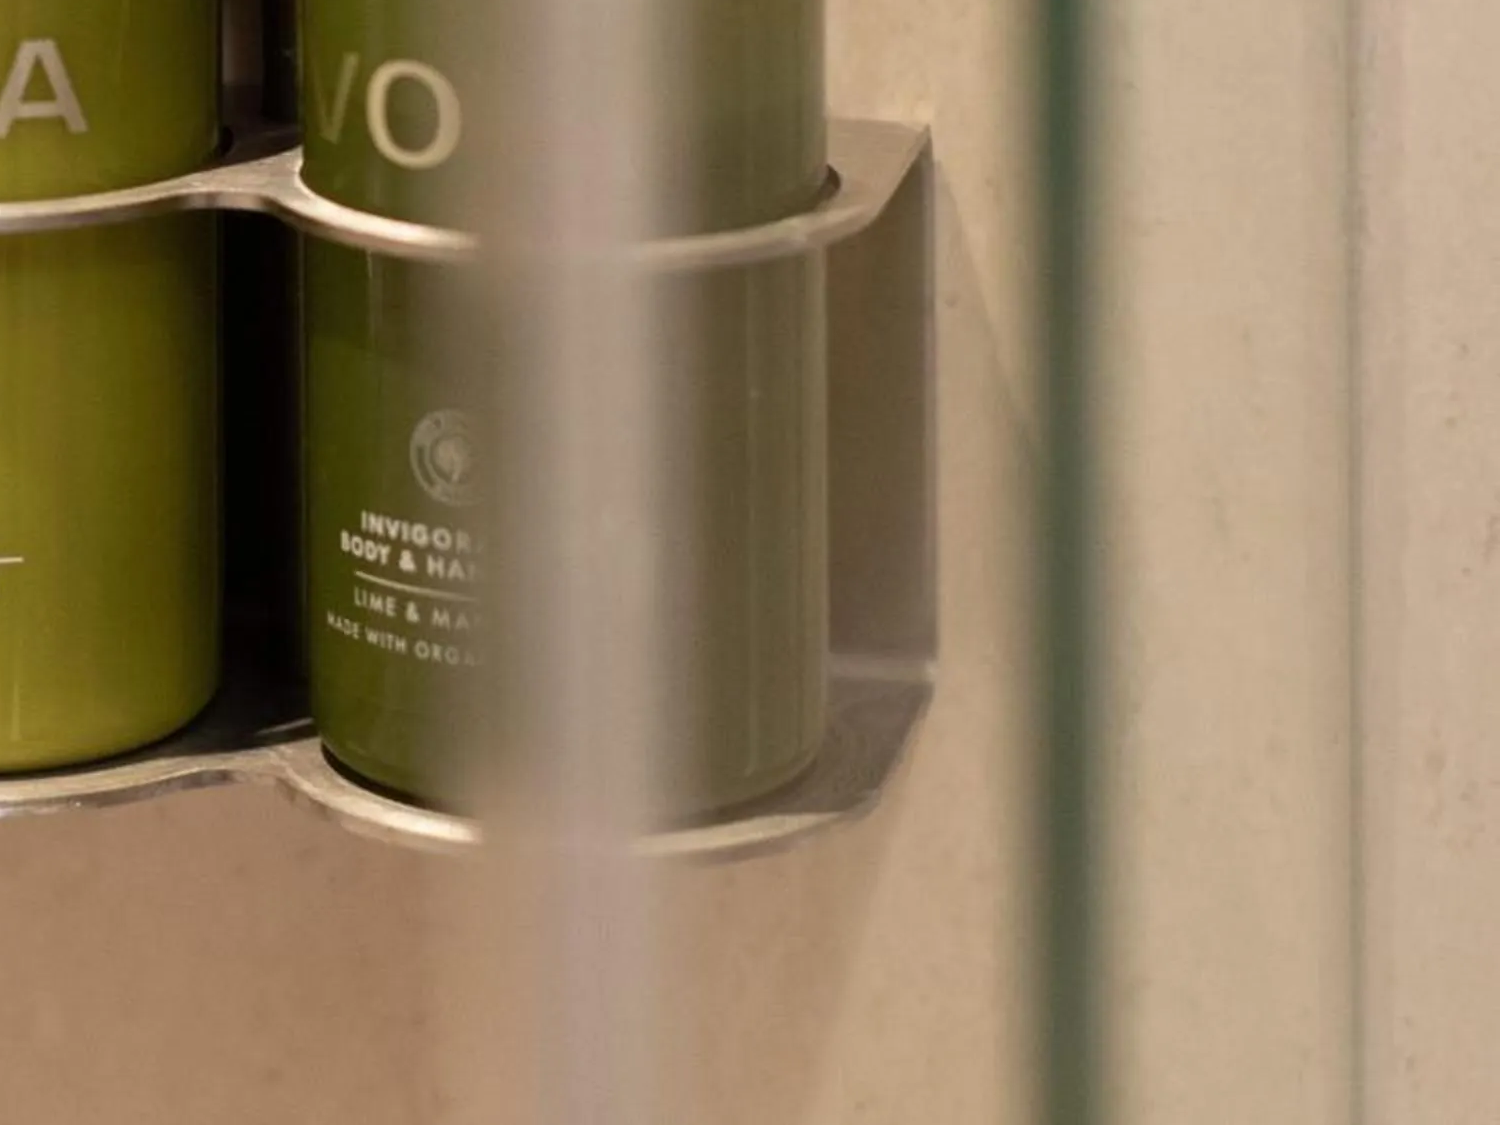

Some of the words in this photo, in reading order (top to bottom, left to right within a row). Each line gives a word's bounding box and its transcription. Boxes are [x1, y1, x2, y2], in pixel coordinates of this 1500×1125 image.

[312, 51, 462, 169] VO
[340, 529, 391, 565] BODY
[399, 550, 416, 572] &
[361, 510, 485, 555] INVIGOR
[354, 586, 397, 617] LIME
[406, 601, 420, 623] &
[432, 607, 481, 630] MA
[365, 626, 408, 654] WITH
[414, 641, 484, 666] ORGA
